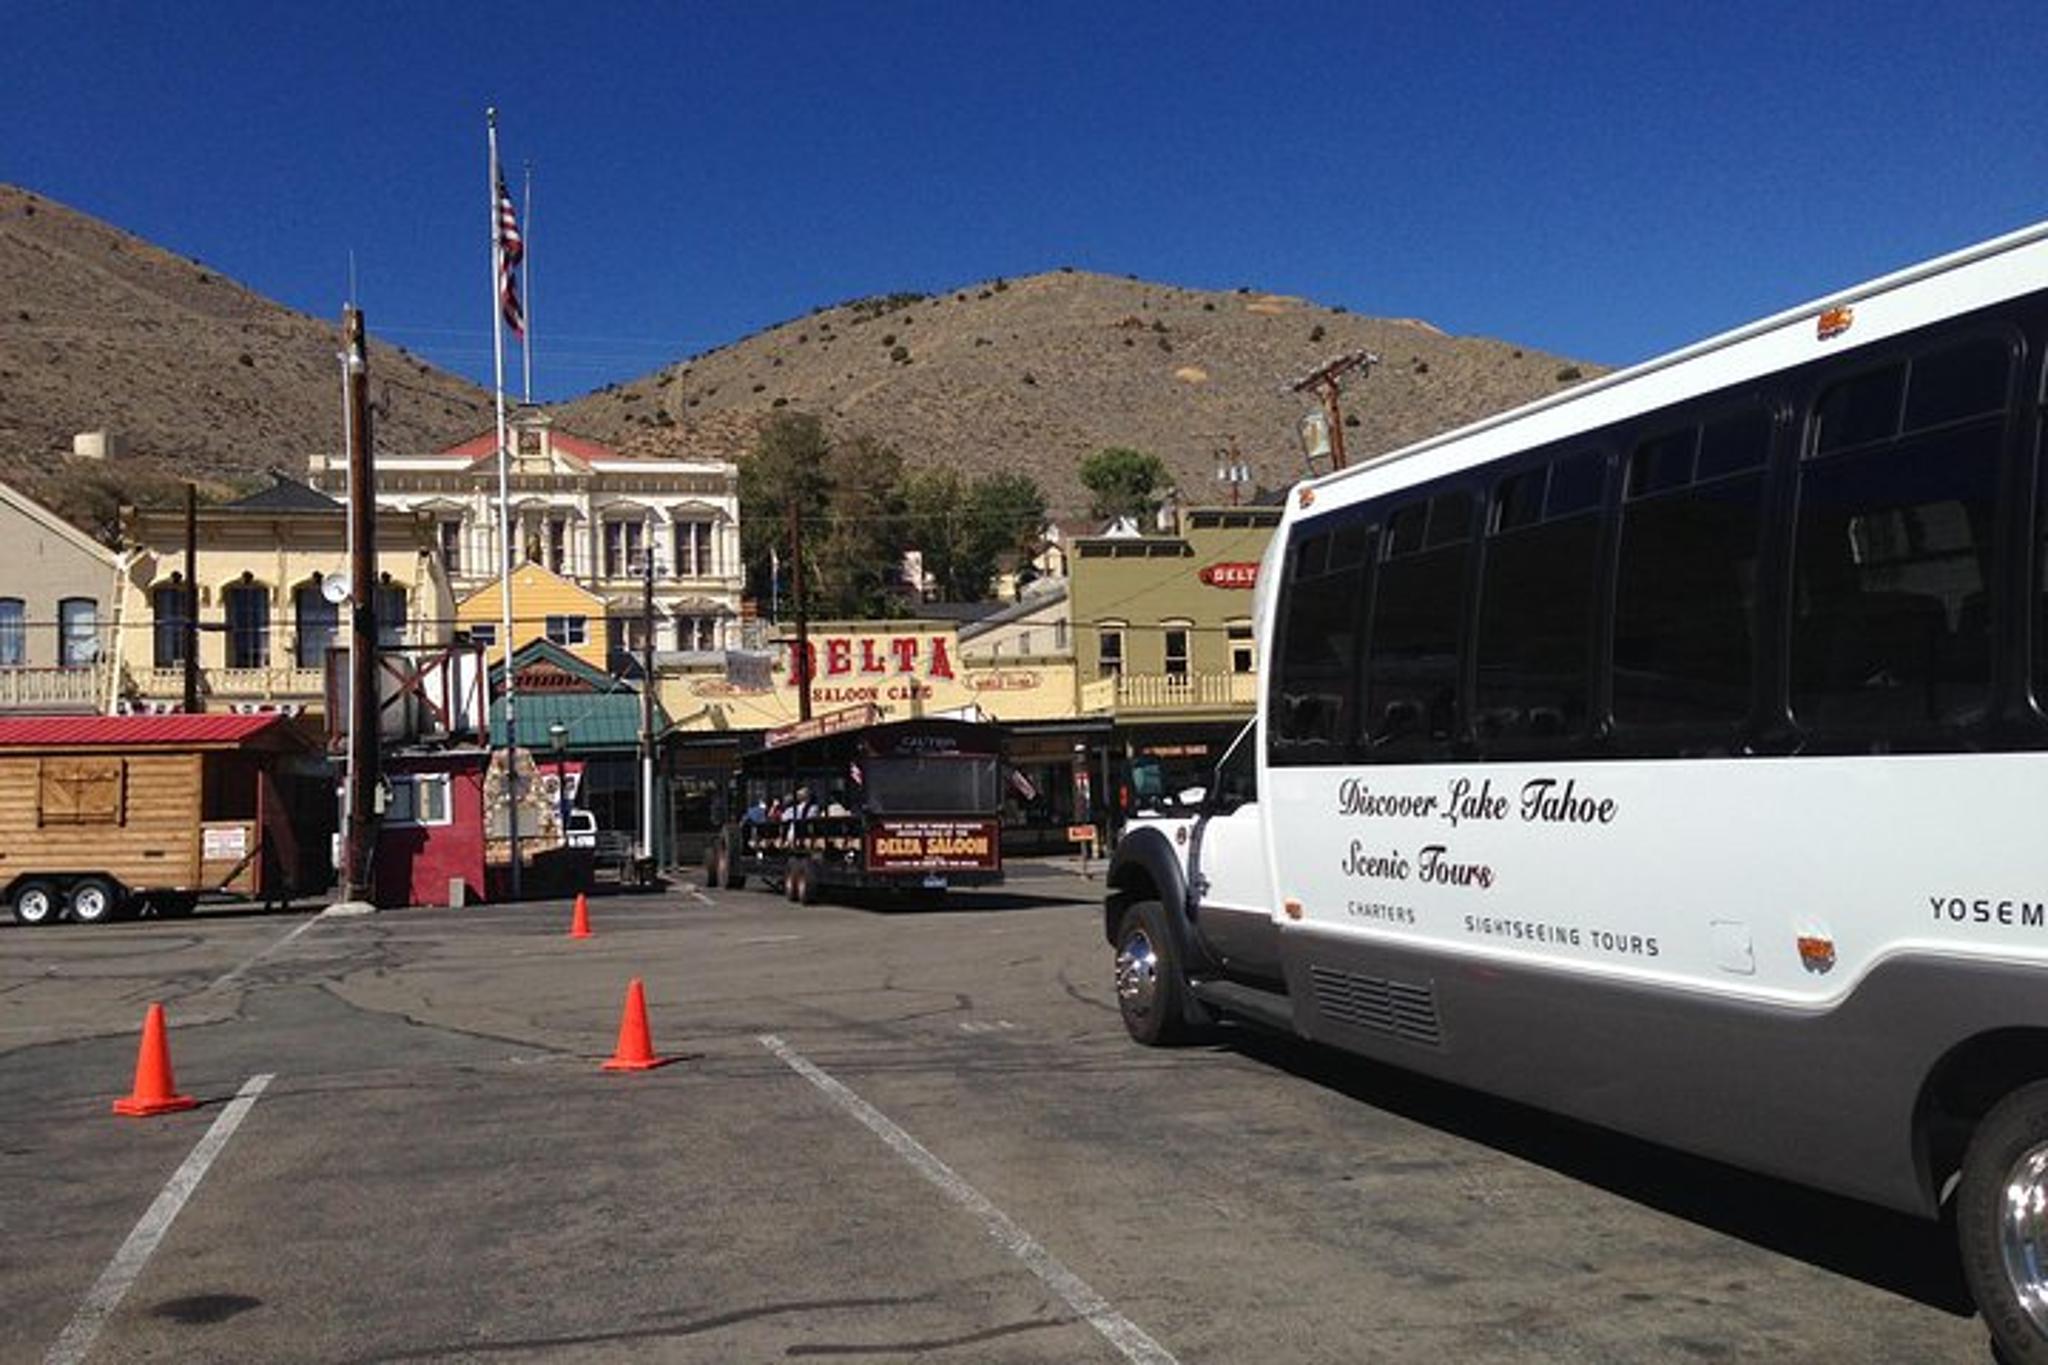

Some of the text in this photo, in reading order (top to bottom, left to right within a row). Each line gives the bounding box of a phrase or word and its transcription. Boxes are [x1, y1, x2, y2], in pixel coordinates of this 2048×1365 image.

[787, 636, 954, 686] DELTA
[812, 686, 879, 701] SALOON
[1339, 777, 1618, 827] Discover Lake Tahoe
[876, 837, 988, 855] DELTA SALOON
[1342, 838, 1494, 889] Scenic Tours
[1347, 900, 1416, 925] CHARTERS
[1929, 897, 2044, 927] YOSEM
[1463, 914, 1660, 957] SIGHTSEEING TOURS
